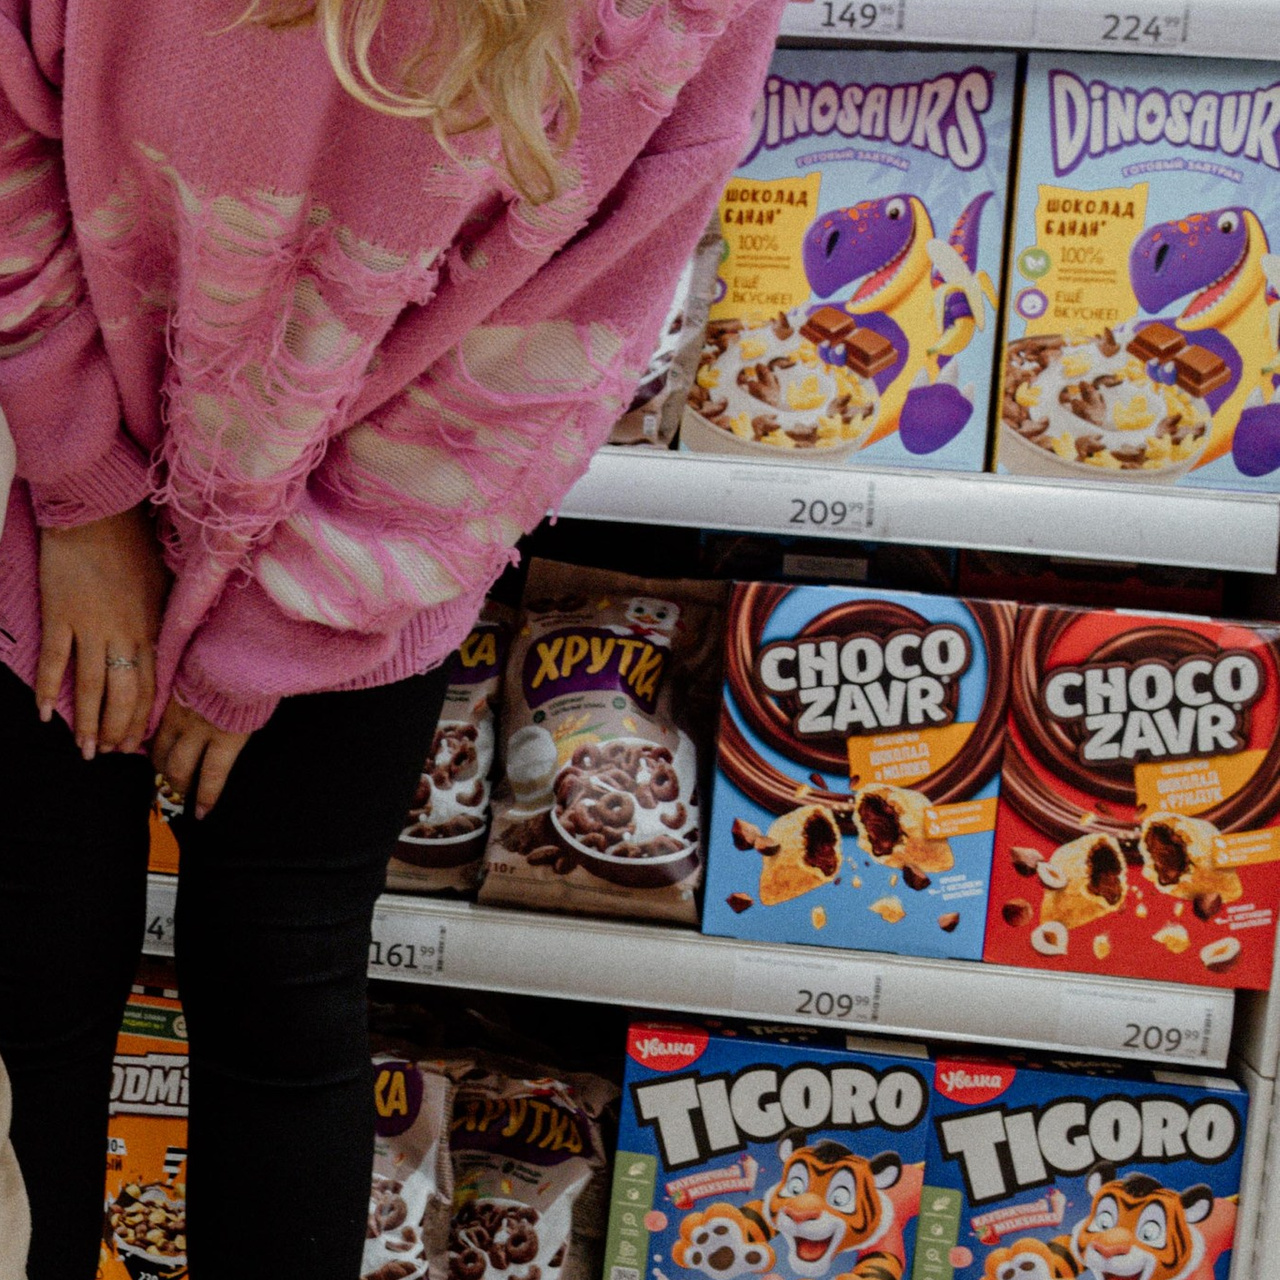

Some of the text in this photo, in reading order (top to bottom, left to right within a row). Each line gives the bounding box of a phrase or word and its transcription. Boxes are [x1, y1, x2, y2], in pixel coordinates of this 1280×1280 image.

[821, 1, 879, 31] 149
[1102, 13, 1163, 44] 224
[1048, 68, 1280, 178] DiNOSAUR
[724, 187, 809, 209] ШОКОЛАД
[1046, 198, 1136, 220] ШОКОЛАД
[737, 234, 780, 252] 100%
[1060, 246, 1105, 265] 100%
[789, 498, 848, 527] 209
[531, 633, 664, 704] ХРУТКА
[760, 626, 968, 693] CHOCO
[1045, 654, 1260, 719] CHOCO
[798, 680, 947, 734] ZAVR
[1085, 704, 1239, 761] ZAVR
[369, 940, 436, 970] 161 99
[795, 990, 870, 1017] 209 99
[1123, 1023, 1200, 1052] 209 99
[636, 1068, 924, 1167] TIGORO
[946, 1100, 1236, 1201] TIGORO
